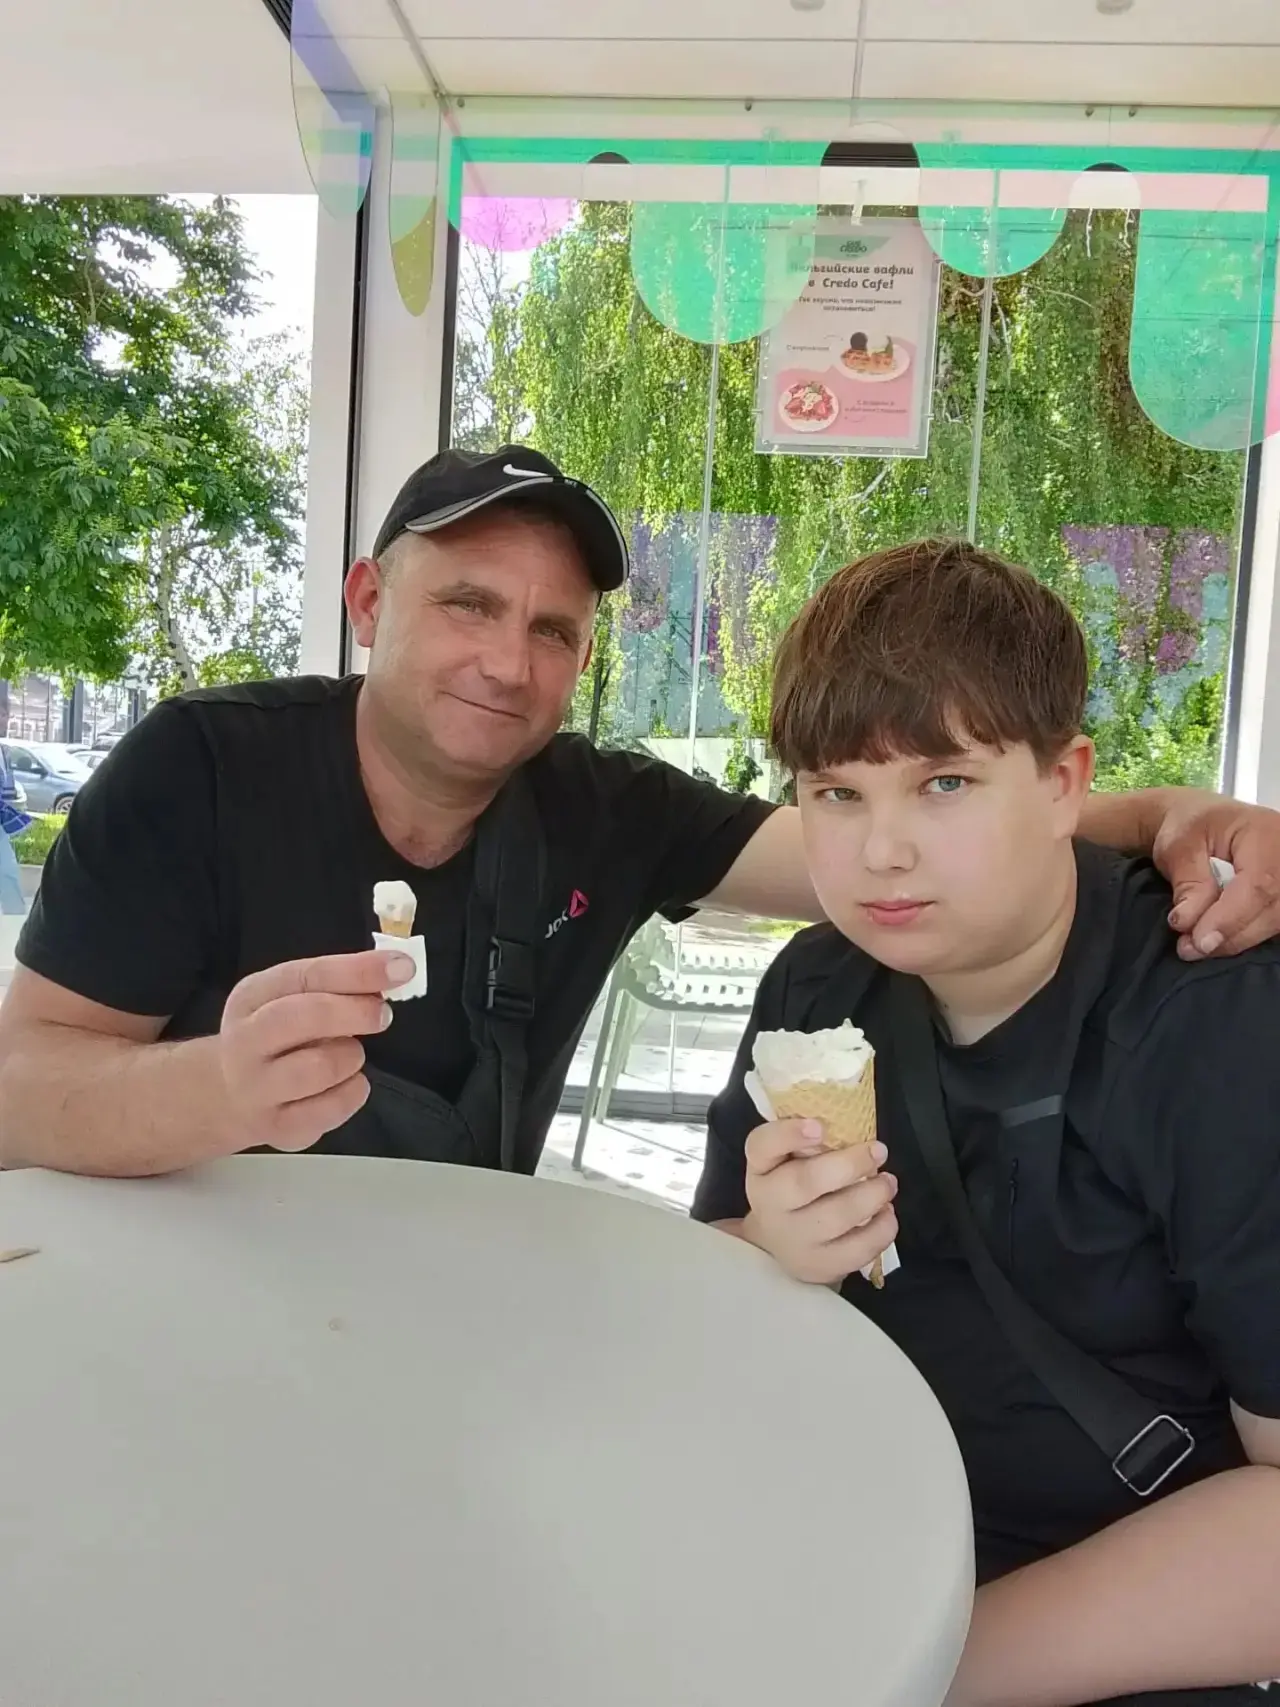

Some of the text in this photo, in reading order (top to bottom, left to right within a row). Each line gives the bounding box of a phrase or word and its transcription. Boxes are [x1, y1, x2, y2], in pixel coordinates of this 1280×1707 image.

[874, 264, 914, 277] вафли
[822, 278, 858, 288] Credo
[862, 279, 894, 292] Cafe!
